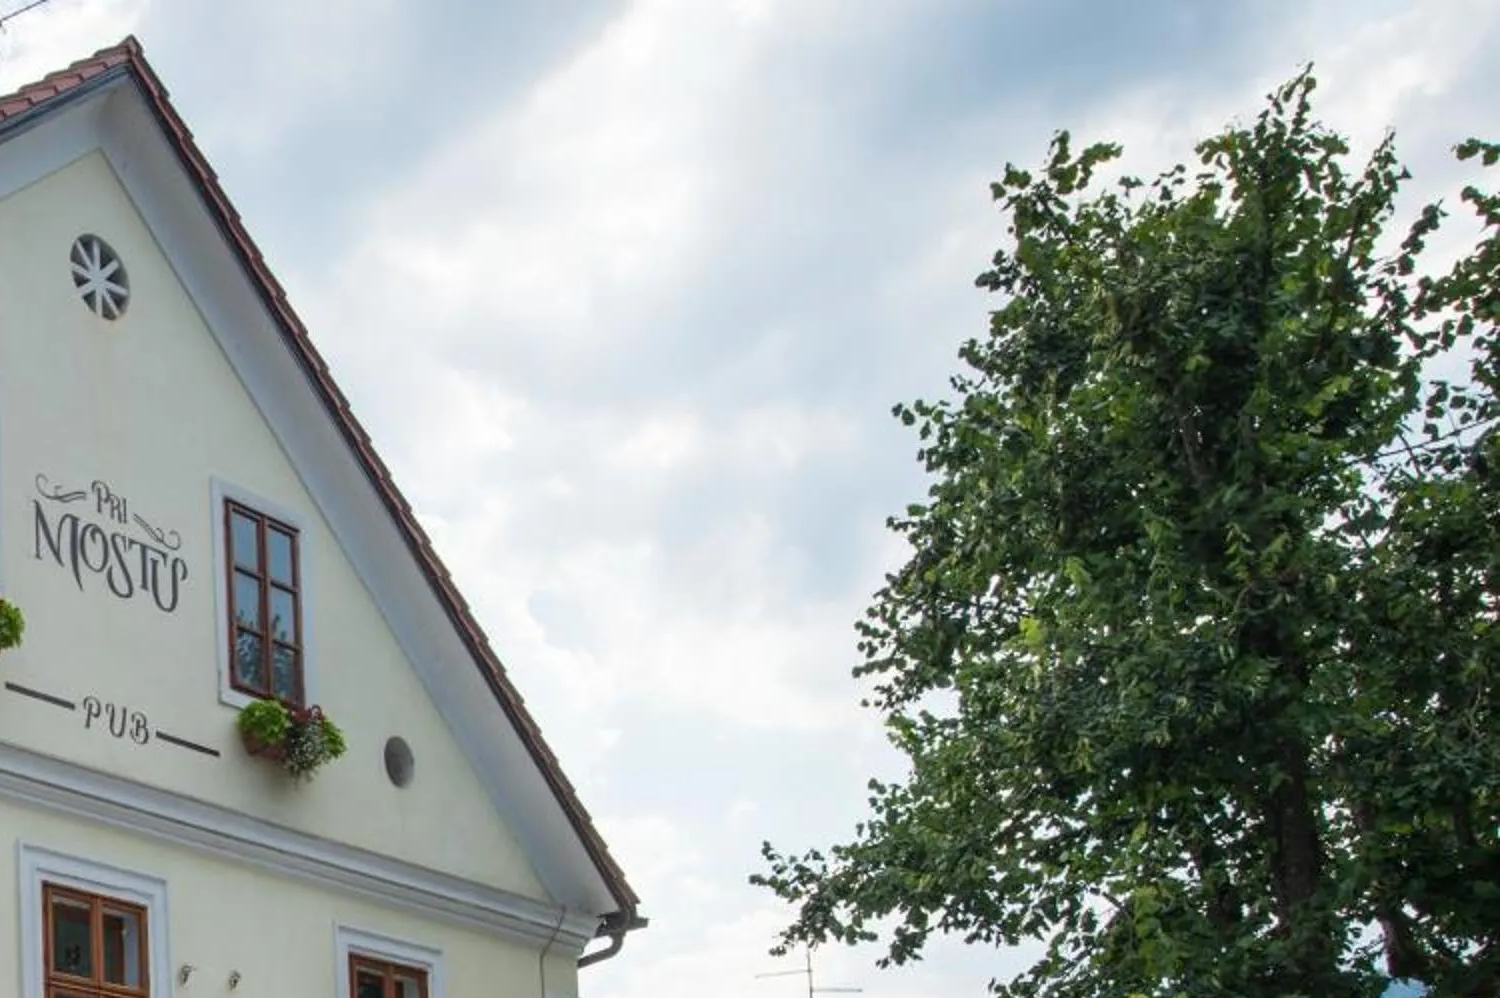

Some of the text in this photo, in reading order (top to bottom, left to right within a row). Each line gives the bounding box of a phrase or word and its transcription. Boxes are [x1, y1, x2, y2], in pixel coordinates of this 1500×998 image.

[91, 480, 127, 524] PRI
[33, 499, 187, 612] MOSTU
[82, 695, 149, 745] PUB
